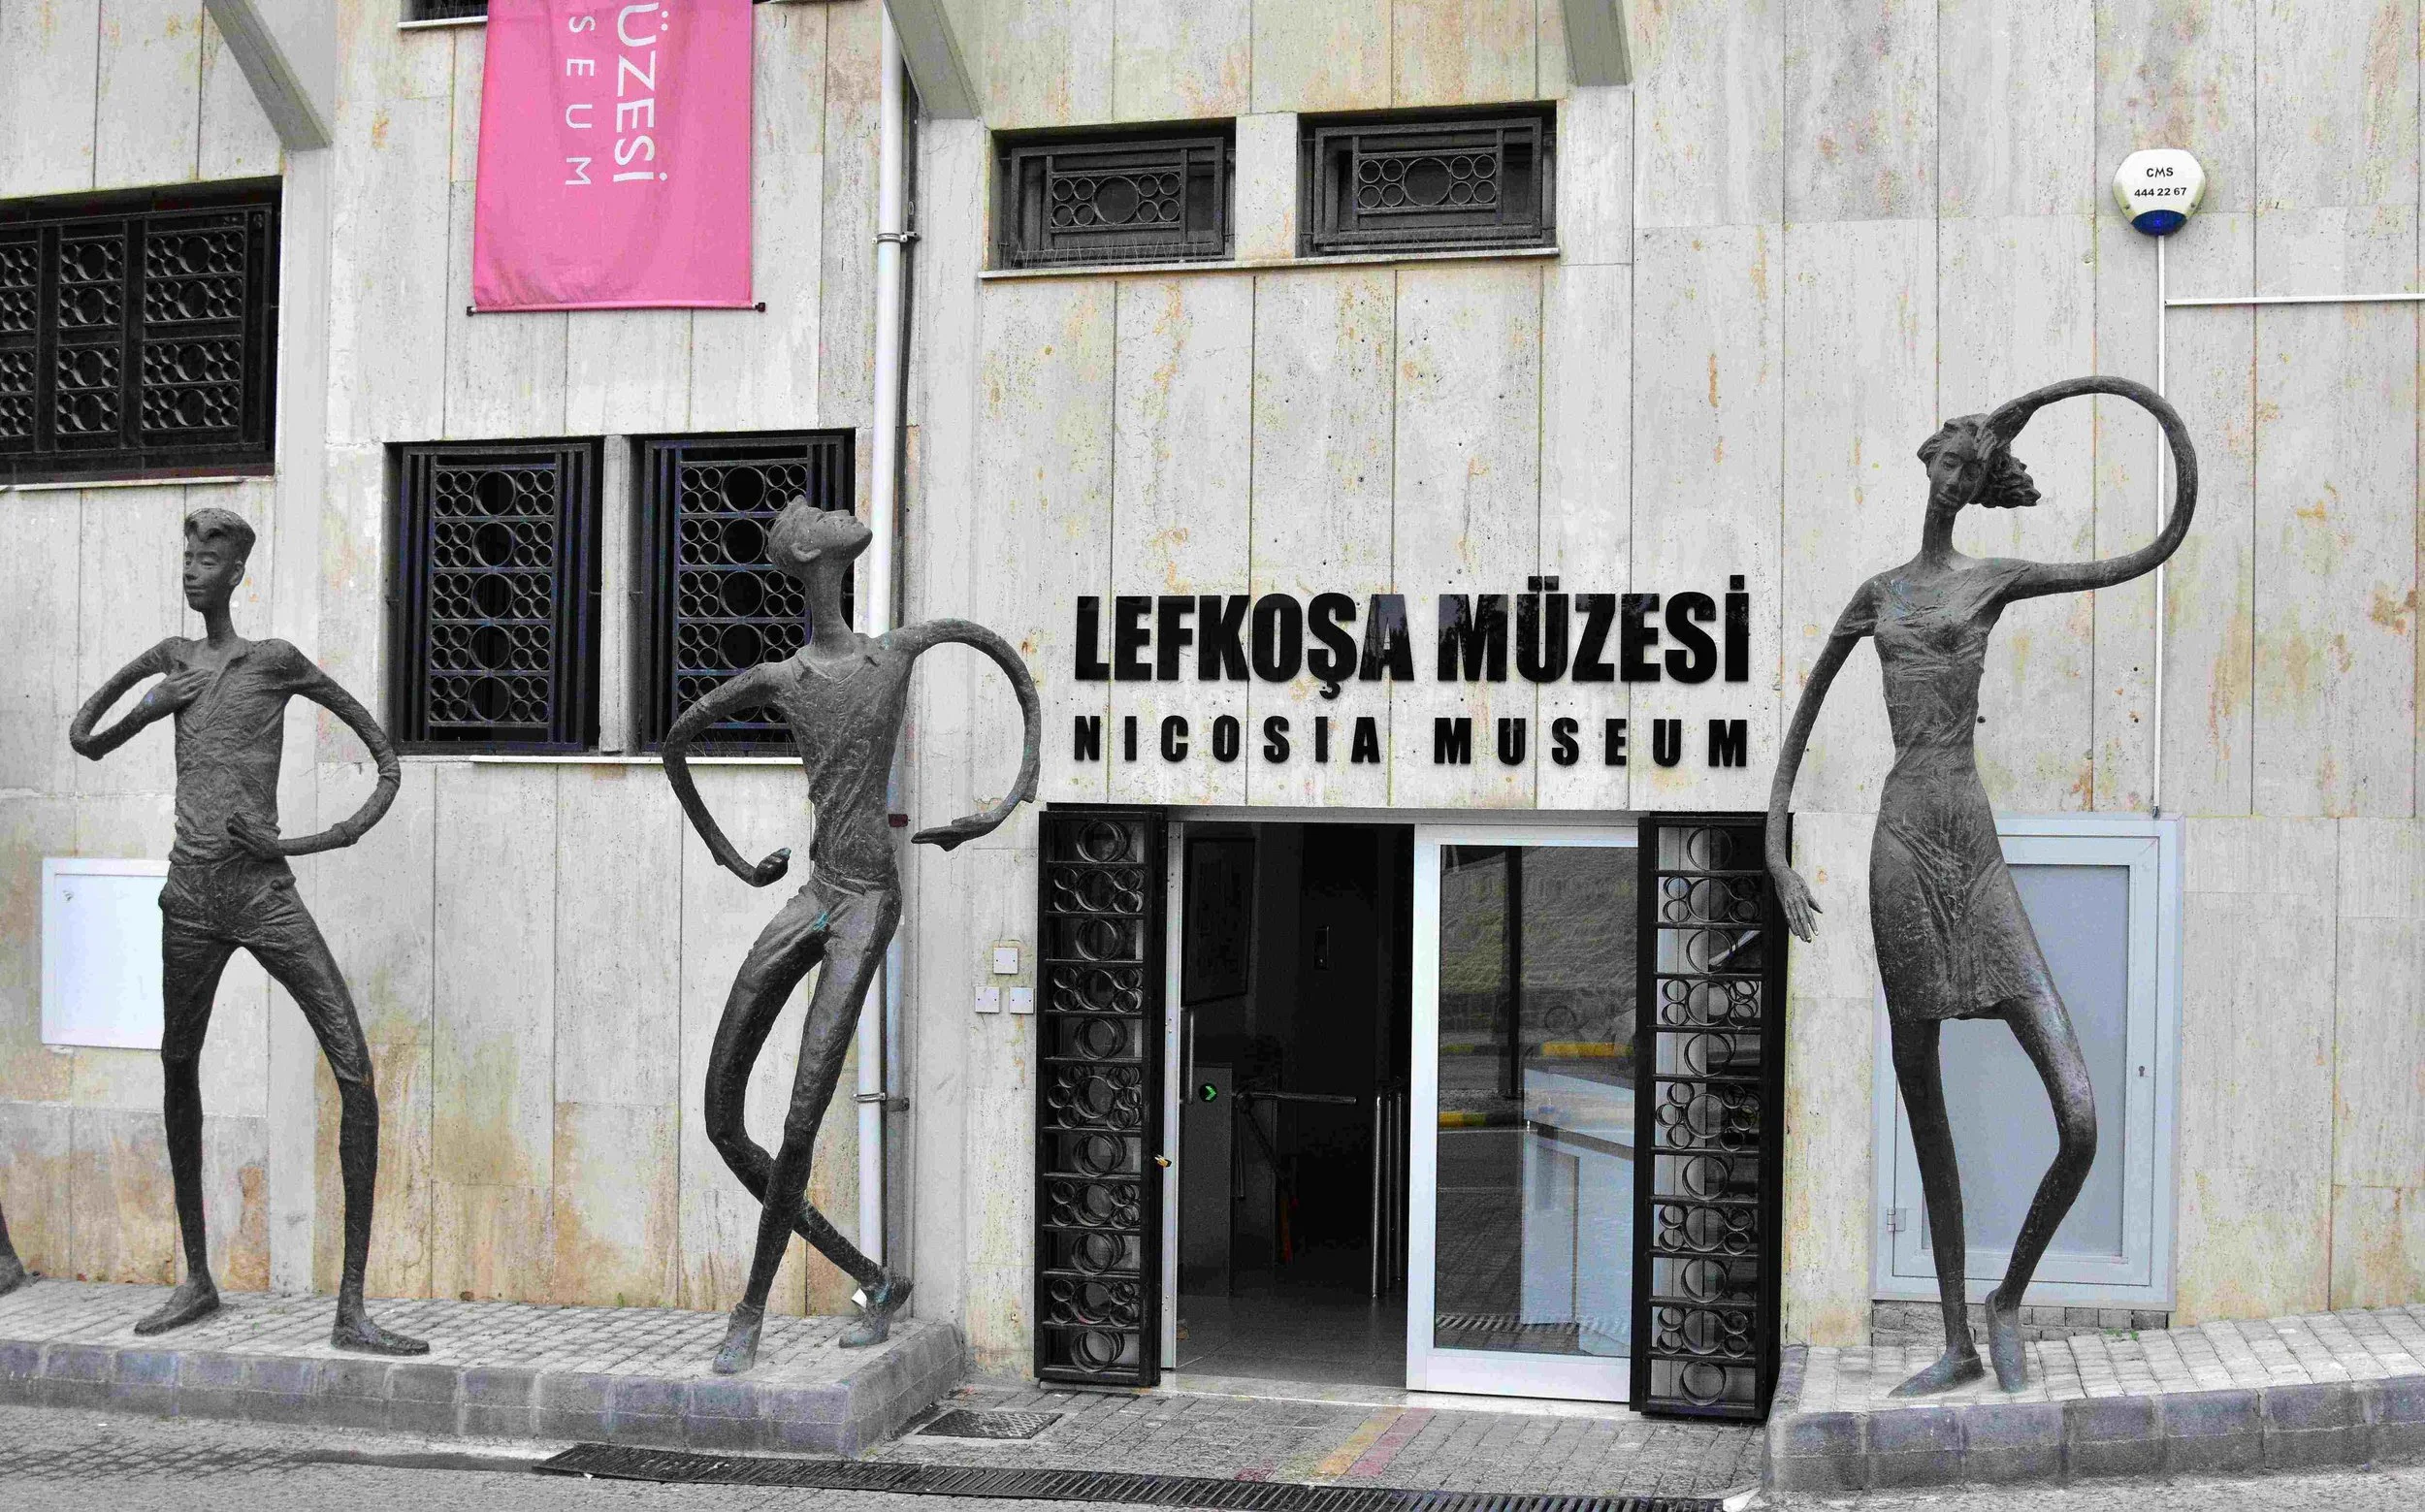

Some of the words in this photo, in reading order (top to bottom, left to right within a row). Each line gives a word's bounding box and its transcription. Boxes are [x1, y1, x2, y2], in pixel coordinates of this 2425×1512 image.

[2146, 167, 2174, 177] CMS
[2134, 188, 2154, 197] 444
[2173, 187, 2187, 196] 67
[1074, 592, 1415, 699] LEFKOŞA
[1437, 575, 1750, 686] MÜZESİ
[1074, 715, 1380, 764] NICOSIA
[1434, 718, 1748, 767] MUSEUM
